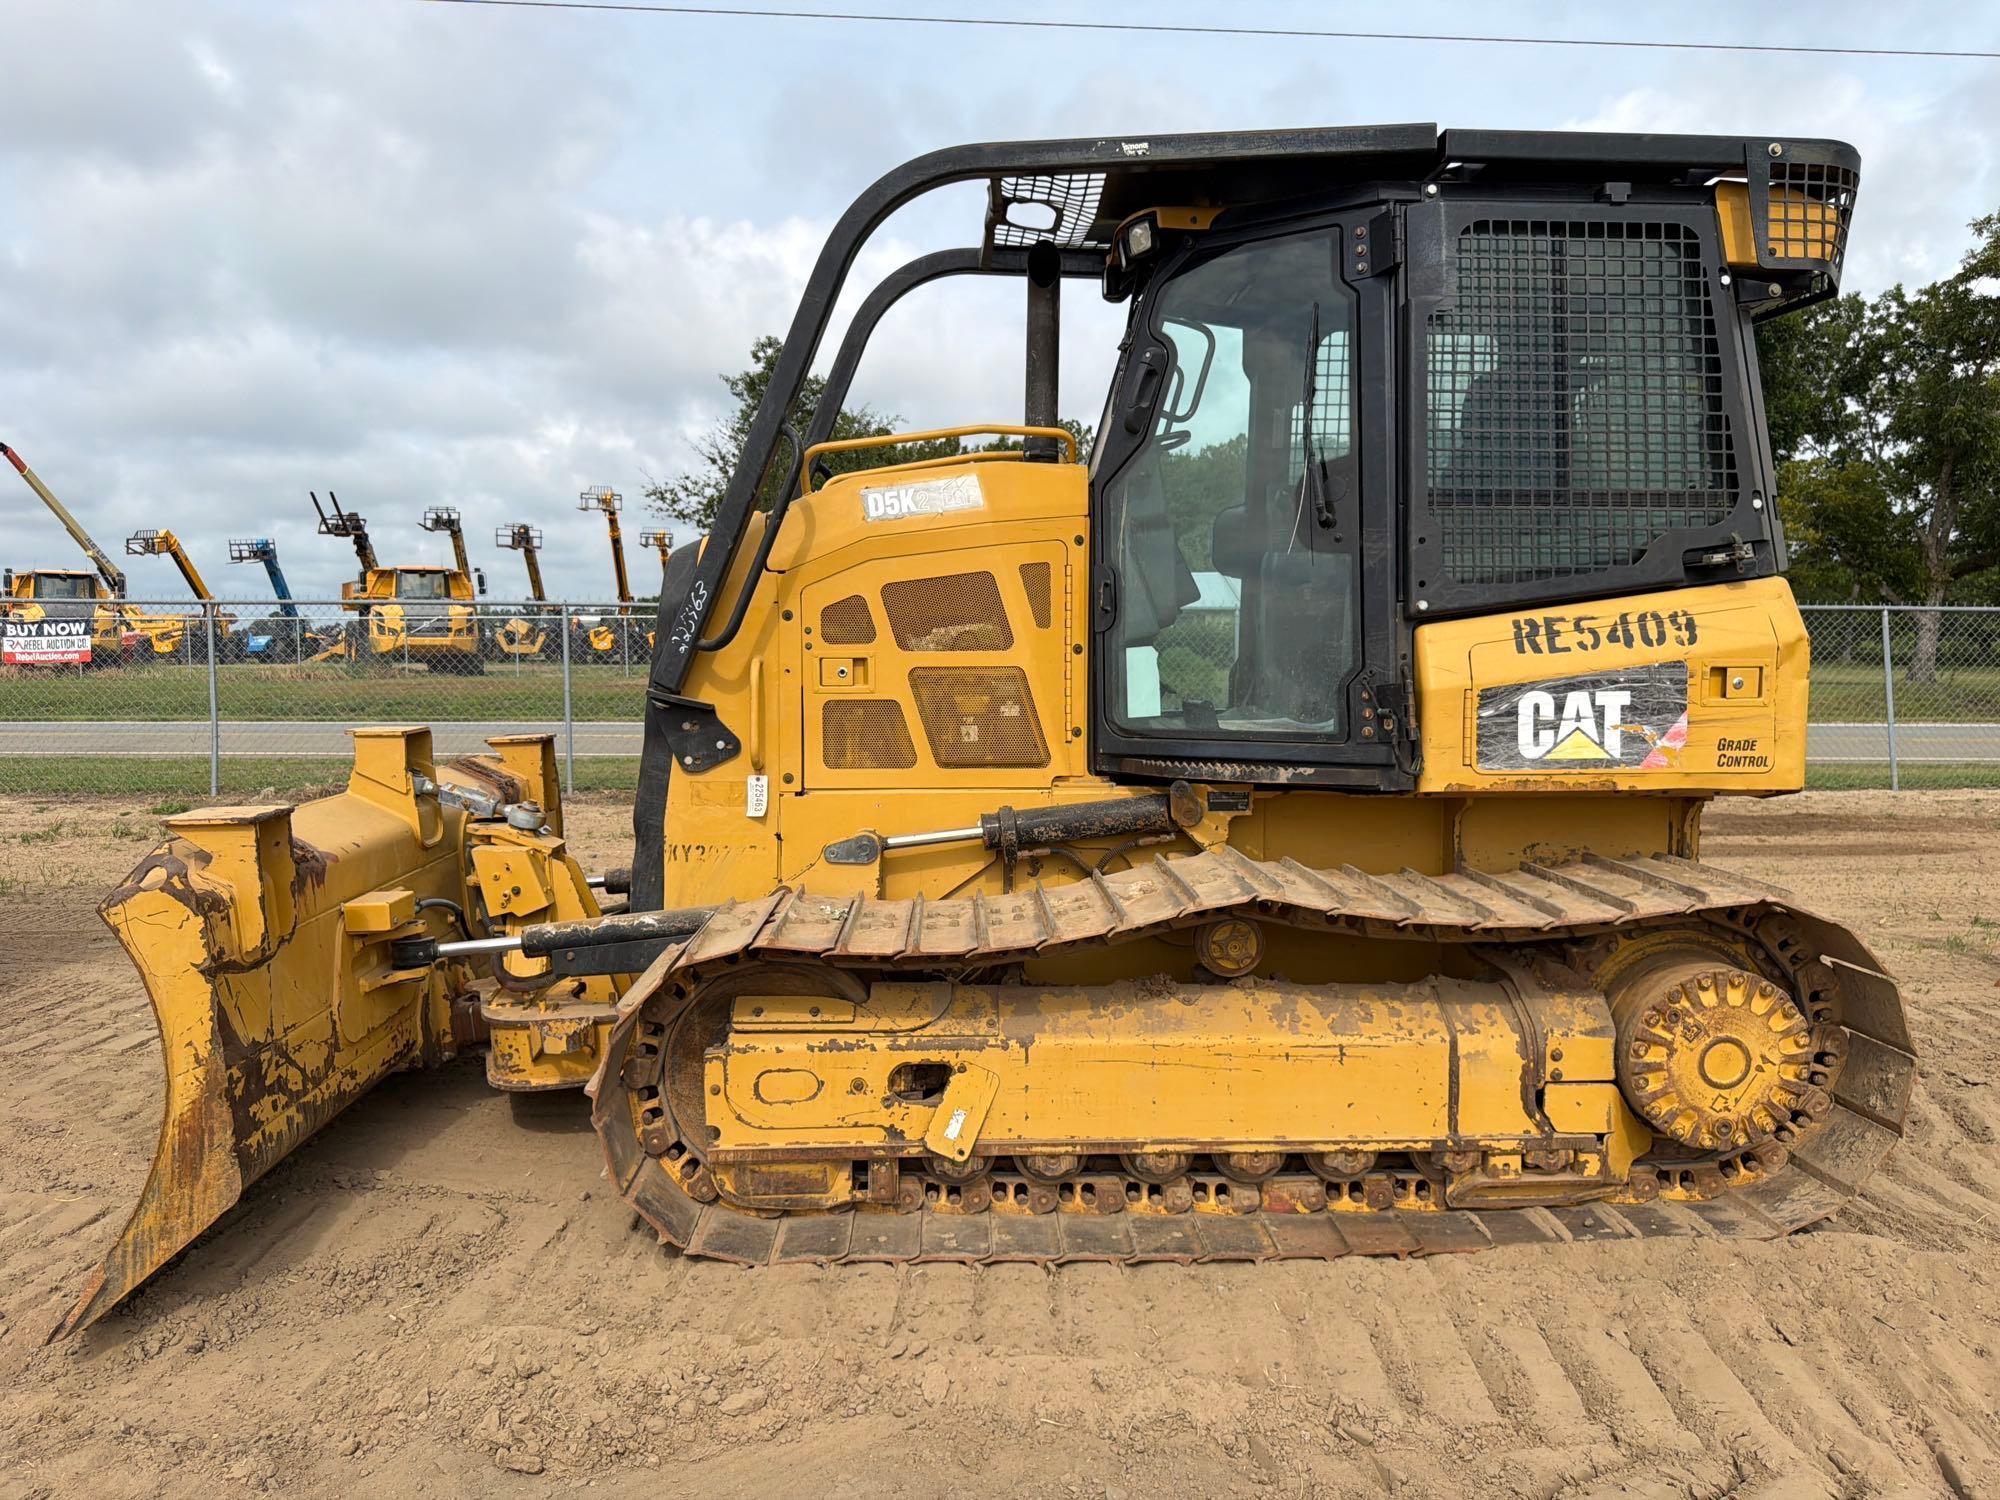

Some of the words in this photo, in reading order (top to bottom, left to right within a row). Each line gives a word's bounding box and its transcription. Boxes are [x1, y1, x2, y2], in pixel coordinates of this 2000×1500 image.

[6, 623, 39, 637] BUY
[43, 622, 86, 636] NOW
[1512, 610, 1698, 655] RE5409
[24, 640, 44, 650] REBEL
[46, 638, 75, 650] AUCTION
[15, 652, 80, 661] RebelAuction.com
[1517, 690, 1631, 760] CAT
[754, 783, 765, 812] 225463
